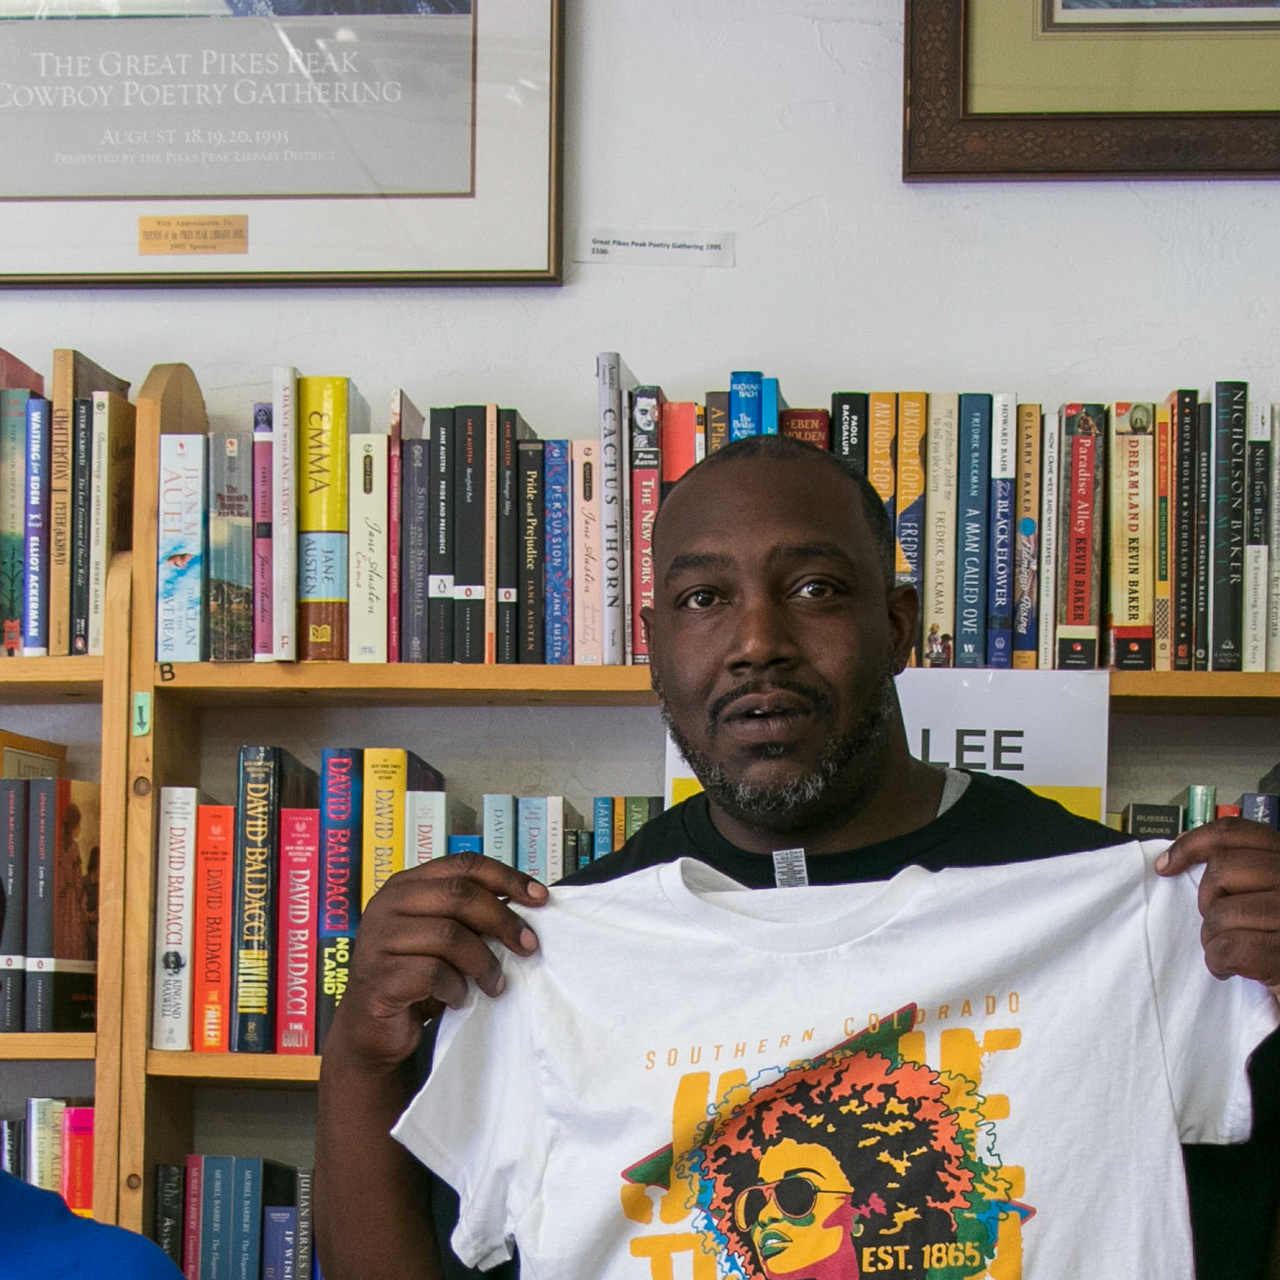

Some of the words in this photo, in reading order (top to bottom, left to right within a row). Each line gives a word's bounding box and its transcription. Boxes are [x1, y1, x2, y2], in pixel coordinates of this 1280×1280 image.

[33, 52, 91, 77] THE
[99, 51, 193, 76] GREAT
[201, 50, 280, 75] PIKES
[287, 50, 359, 74] PEAK
[123, 82, 227, 107] POETRY
[234, 80, 402, 104] GATHERING
[101, 129, 177, 146] AUGUST
[592, 238, 610, 246] Great
[672, 242, 703, 251] Gathering
[308, 410, 330, 494] EMMA
[604, 408, 618, 504] CACTUS
[1077, 438, 1091, 495] Paradise
[1231, 389, 1245, 509] NICHOLSON
[162, 468, 183, 540] AUEL
[1127, 439, 1139, 533] DREAMLAND
[551, 485, 562, 568] PERSUASION
[936, 511, 946, 558] FREDRIK
[1076, 500, 1089, 534] Alley
[29, 536, 40, 571] ELLIOT
[304, 537, 316, 595] AUSTEN
[322, 548, 334, 584] JANE
[605, 520, 620, 608] THORN
[1075, 537, 1087, 575] KEVIN
[1128, 537, 1140, 576] KEVIN
[1230, 520, 1242, 585] BAKER
[28, 574, 40, 637] ACKERMAN
[933, 560, 944, 615] BACKMAN
[1074, 578, 1086, 621] BAKER
[1128, 578, 1140, 621] BAKER
[159, 663, 176, 682] B
[920, 727, 1025, 770] LEE
[246, 782, 269, 841] DAVID
[327, 757, 352, 821] DAVID
[1136, 814, 1176, 825] RUSSELL
[169, 826, 187, 871] DAVID
[243, 847, 268, 942] BALDACCI
[288, 869, 311, 924] DAVID
[325, 827, 351, 931] BALDACCI
[165, 874, 185, 947] BALDACCI
[238, 949, 269, 1015] DAYLIGHT
[286, 929, 309, 1017] BALDACCI
[323, 947, 336, 996] LAND
[644, 1026, 817, 1071] SOUTHERN
[843, 991, 1021, 1037] COLORADO
[299, 1173, 311, 1218] JULIAN
[298, 1221, 309, 1269] BARNES
[861, 1245, 914, 1273] EST.
[921, 1241, 982, 1271] 1865
